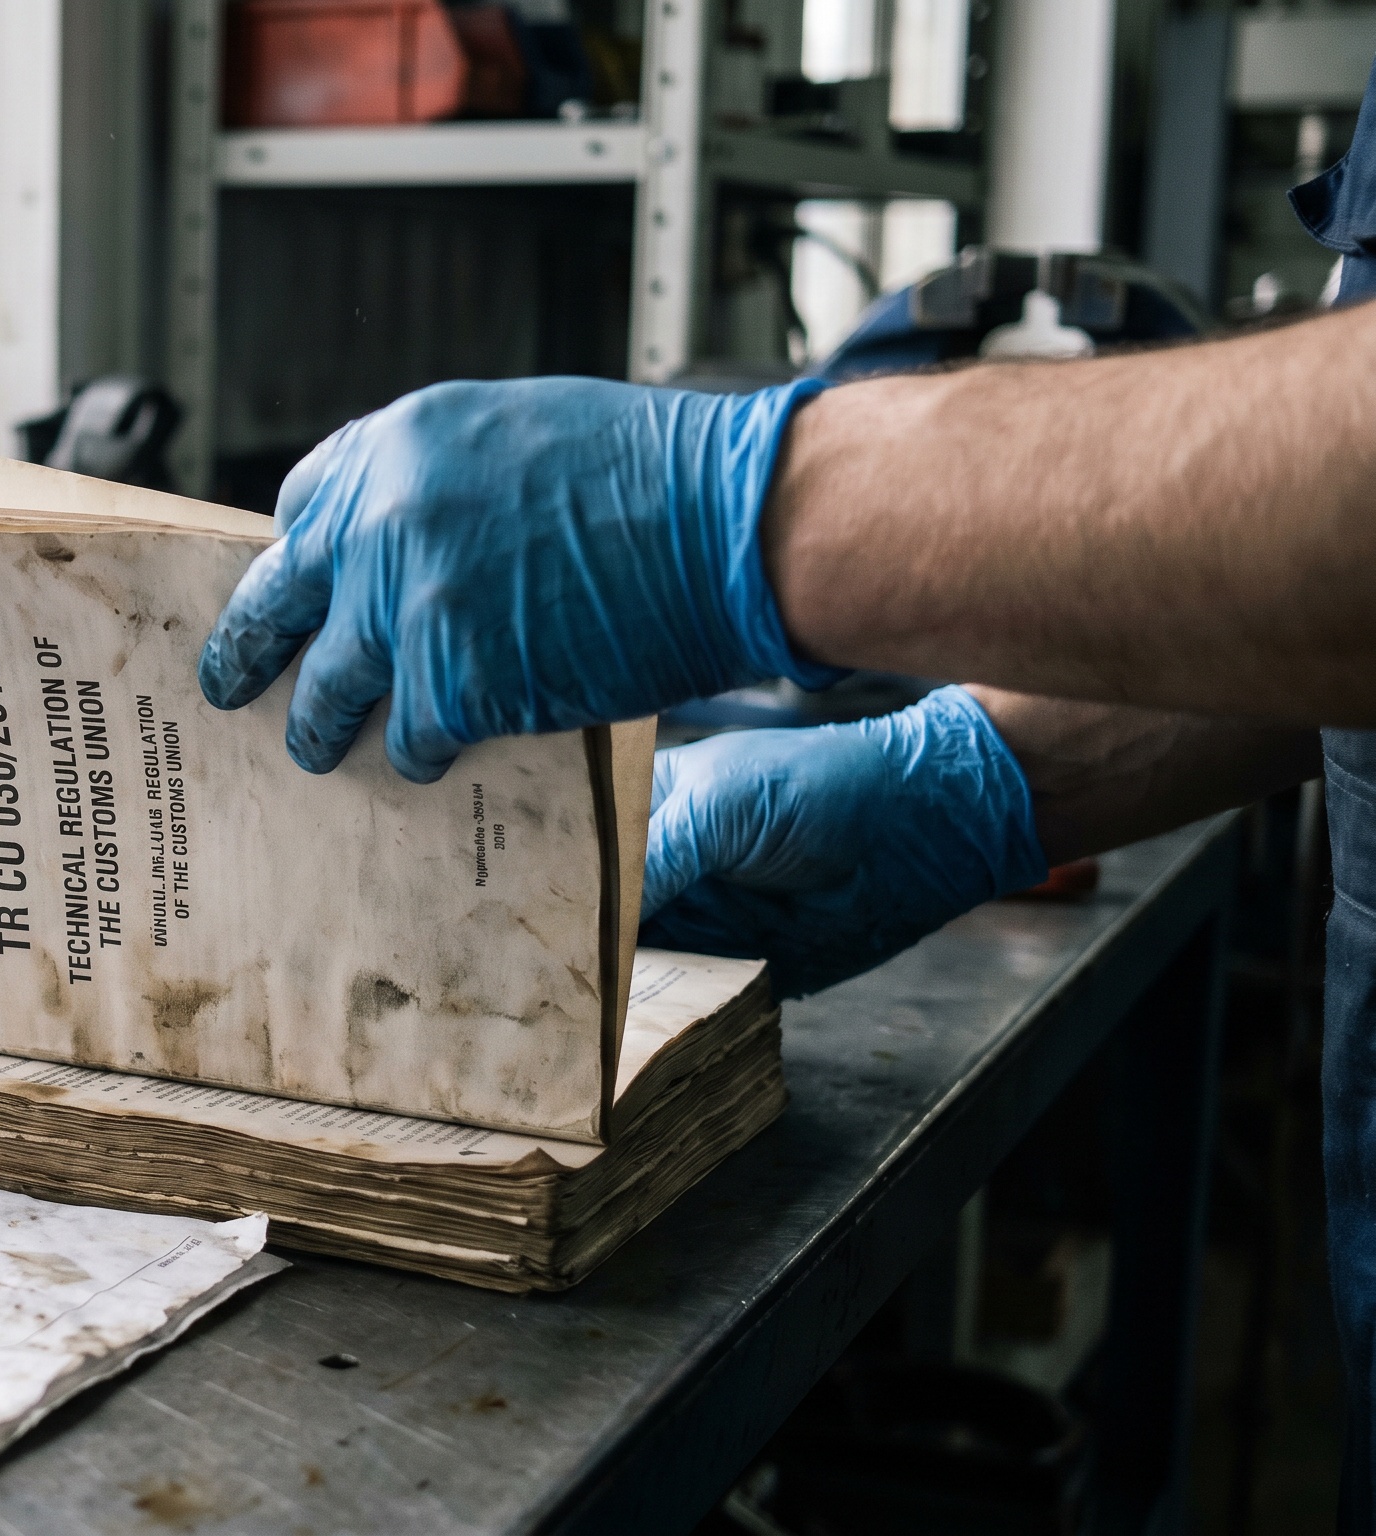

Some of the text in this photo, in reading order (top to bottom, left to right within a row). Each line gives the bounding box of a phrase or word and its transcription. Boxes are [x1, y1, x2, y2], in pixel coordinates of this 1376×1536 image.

[33, 636, 92, 985] TECHNICAL REGULATION OF
[76, 680, 122, 949] THE CUSTOMS UNION
[136, 695, 163, 801] REGULATION
[163, 721, 190, 919] OF THE CUSTOMS UNION
